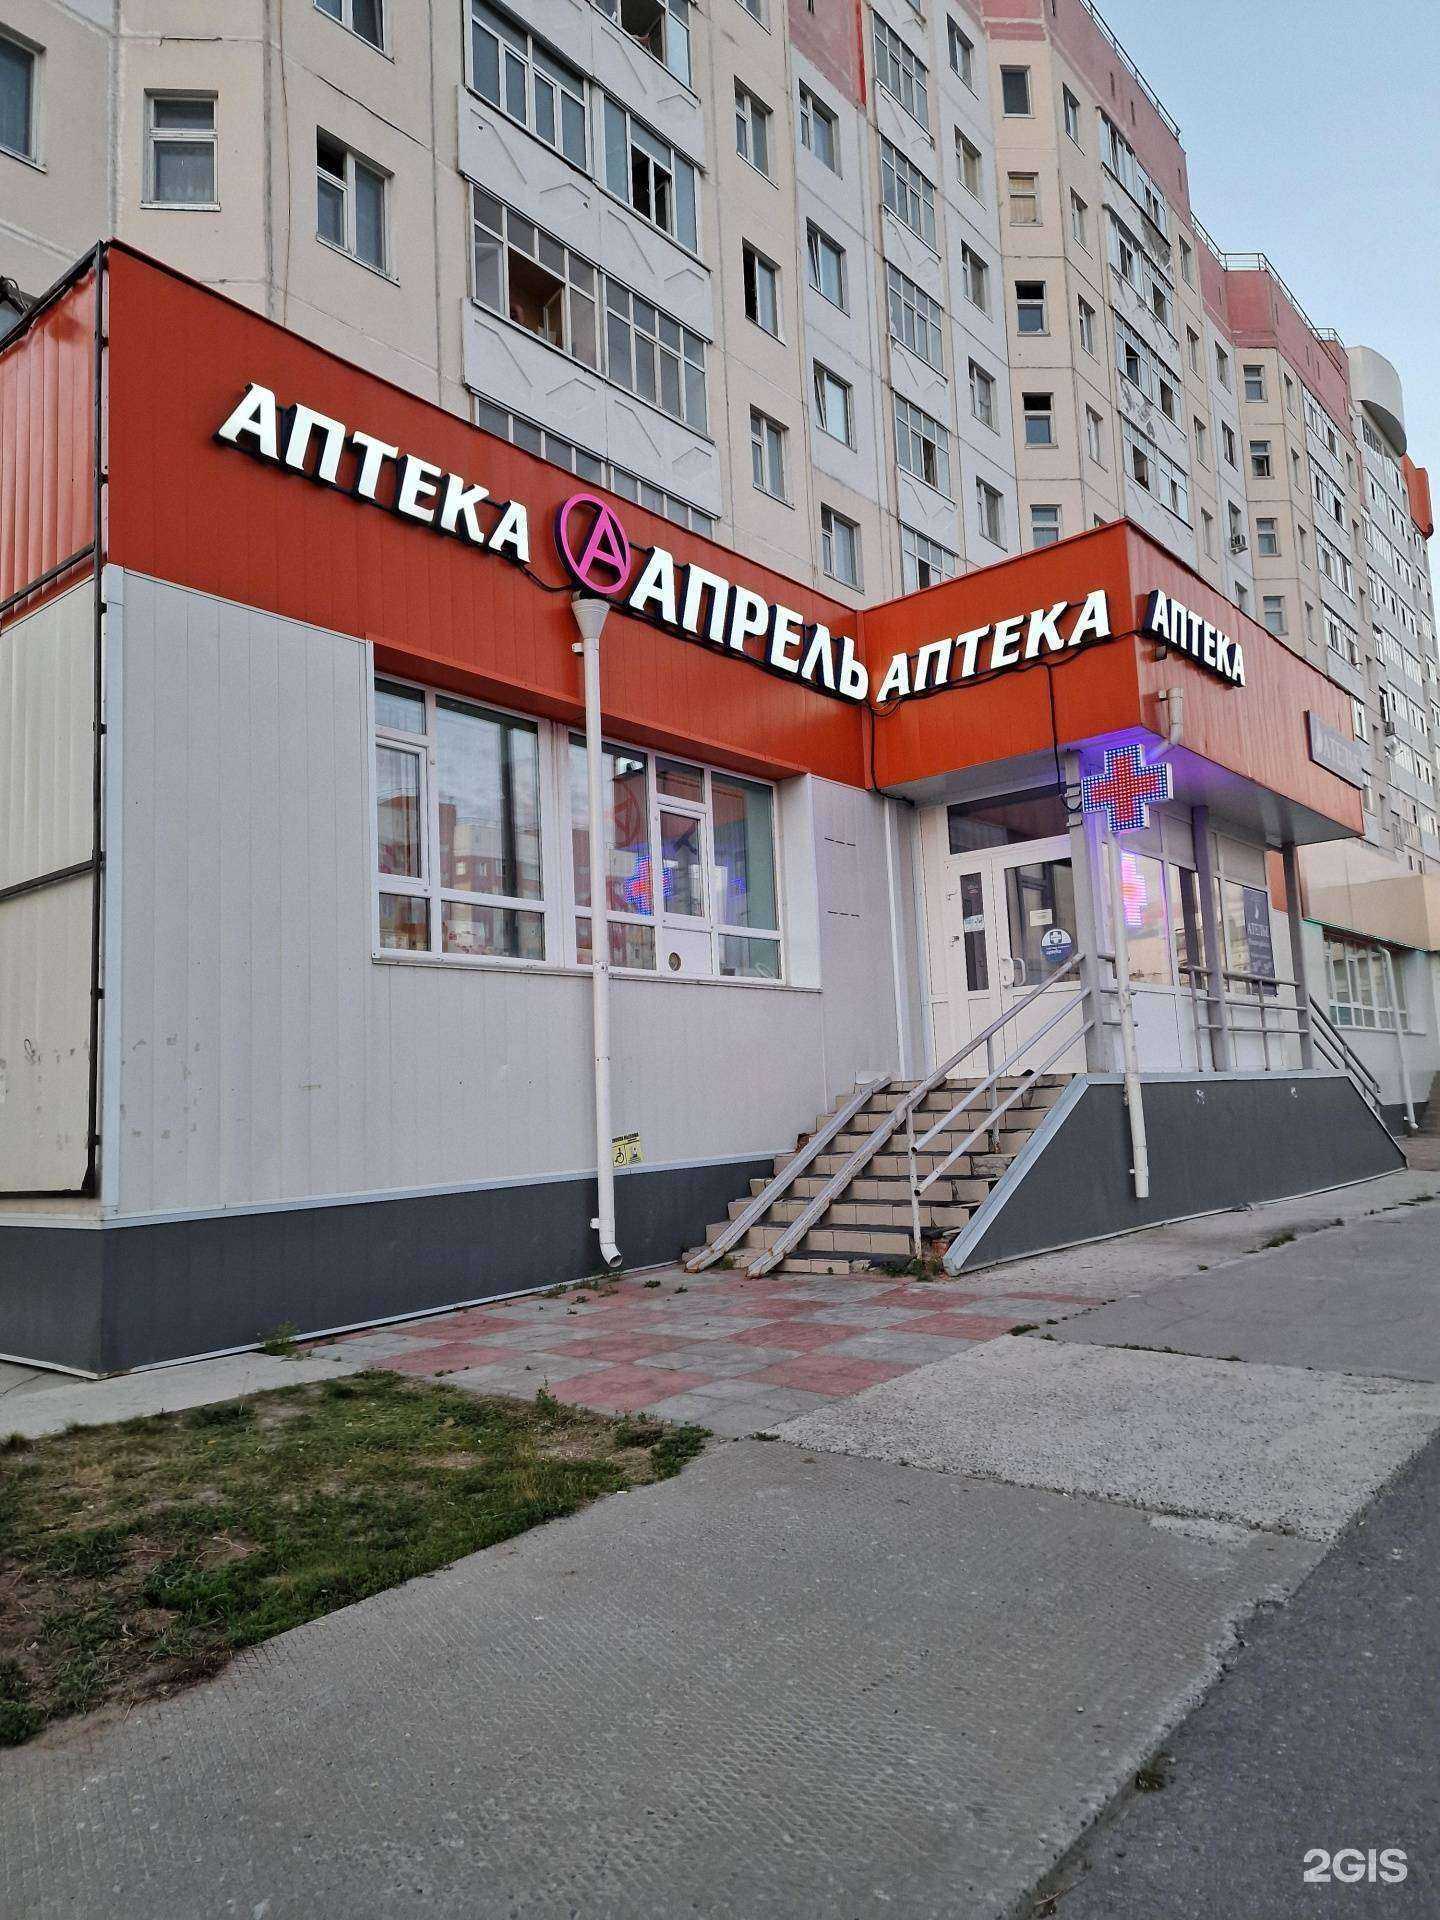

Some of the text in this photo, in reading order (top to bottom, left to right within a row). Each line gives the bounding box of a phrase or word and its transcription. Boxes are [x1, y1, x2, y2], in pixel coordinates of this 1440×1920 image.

[218, 382, 530, 563] АПТЕКА
[629, 545, 870, 702] АПРЕЛЬ
[876, 589, 1112, 703] АПТЕКА
[1150, 588, 1247, 688] АПТЕКА
